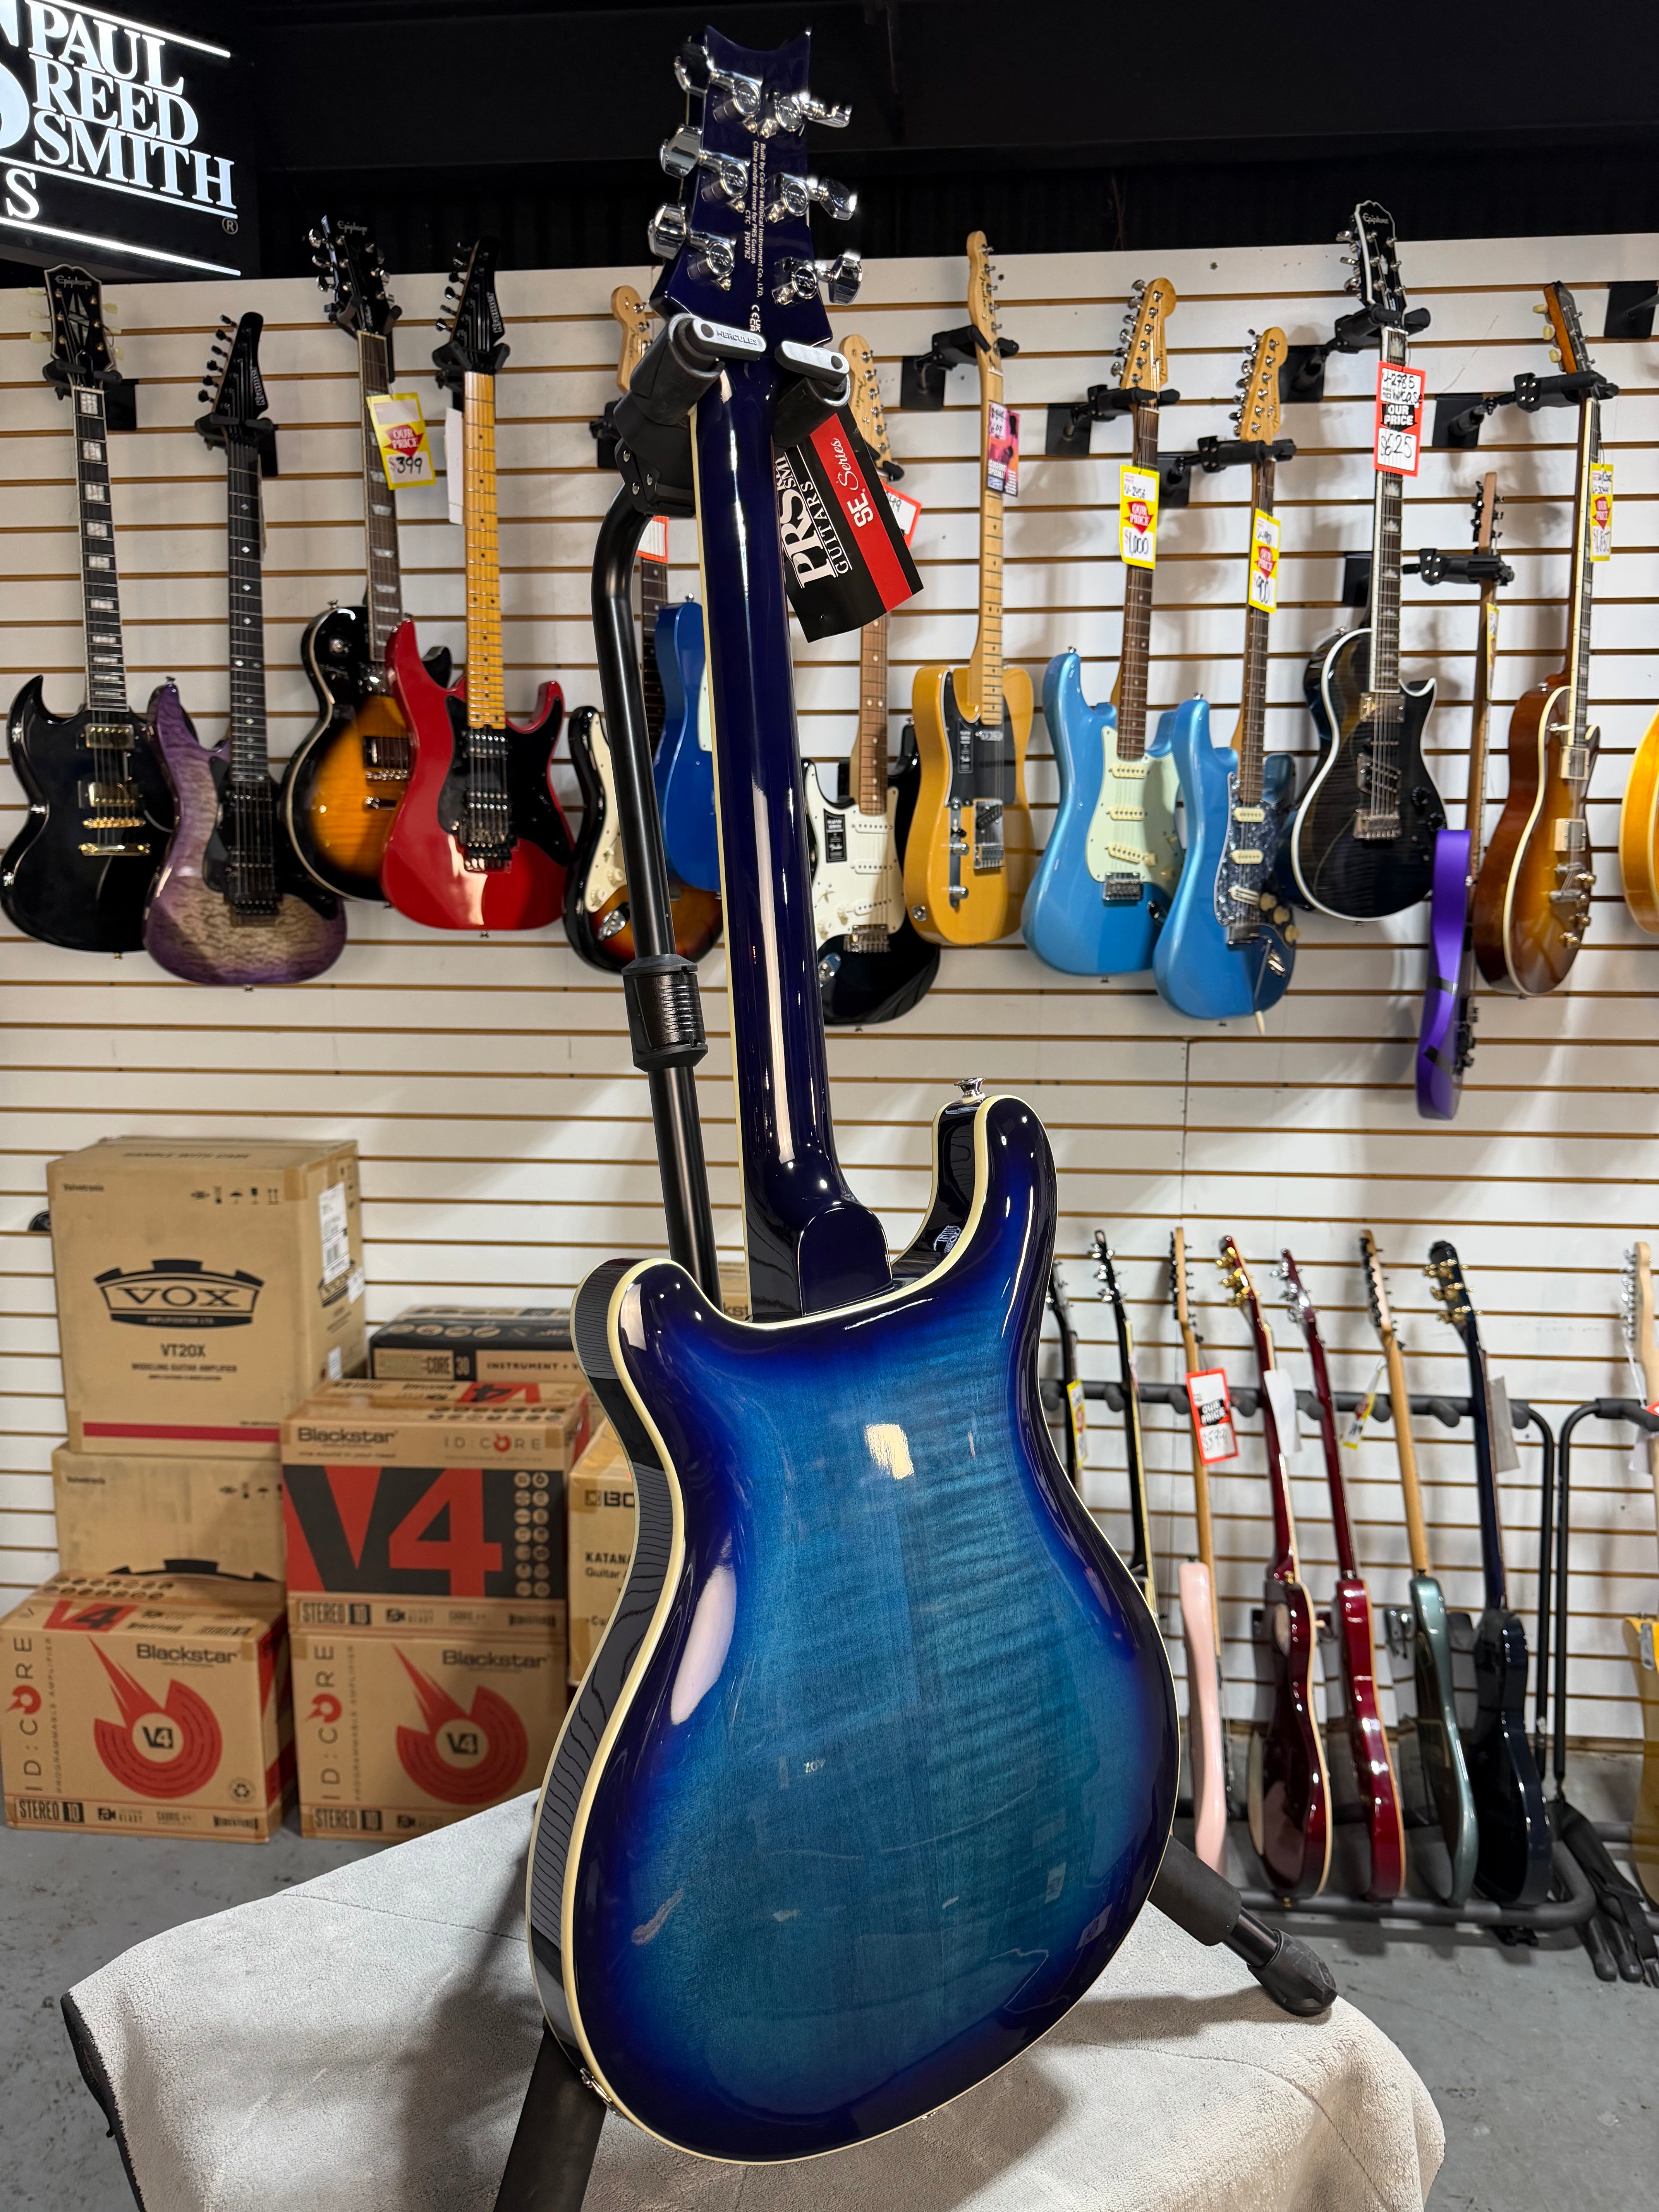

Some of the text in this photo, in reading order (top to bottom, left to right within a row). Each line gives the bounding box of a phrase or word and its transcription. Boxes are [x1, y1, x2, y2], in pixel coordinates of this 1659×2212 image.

[25, 0, 184, 95] PAUL
[29, 54, 198, 146] REED
[34, 110, 237, 210] SMITH
[759, 161, 766, 171] by
[716, 329, 758, 346] HERCULES
[1387, 405, 1409, 415] OUR
[1384, 414, 1414, 426] PRICE
[392, 428, 414, 440] OUR
[392, 437, 419, 449] PRICE
[388, 456, 422, 475] $399
[830, 438, 859, 491] Series
[1131, 502, 1148, 516] OUR
[800, 481, 848, 574] GUITARS
[1129, 513, 1150, 527] PRICE
[780, 489, 836, 588] PRS
[117, 1285, 240, 1308] VOX
[160, 1343, 206, 1358] VT20X
[486, 1361, 559, 1370] INSTRUMENT
[1202, 1399, 1221, 1414] OUR
[1200, 1407, 1226, 1426] PRICE
[297, 1426, 397, 1445] Blackstar
[283, 1466, 503, 1597] V4
[585, 1567, 620, 1578] Guitar
[136, 1643, 235, 1664] Blackstar
[442, 1649, 545, 1669] Blackstar
[141, 1726, 174, 1749] V4
[446, 1732, 478, 1755] V4
[19, 1800, 60, 1820] STEREO
